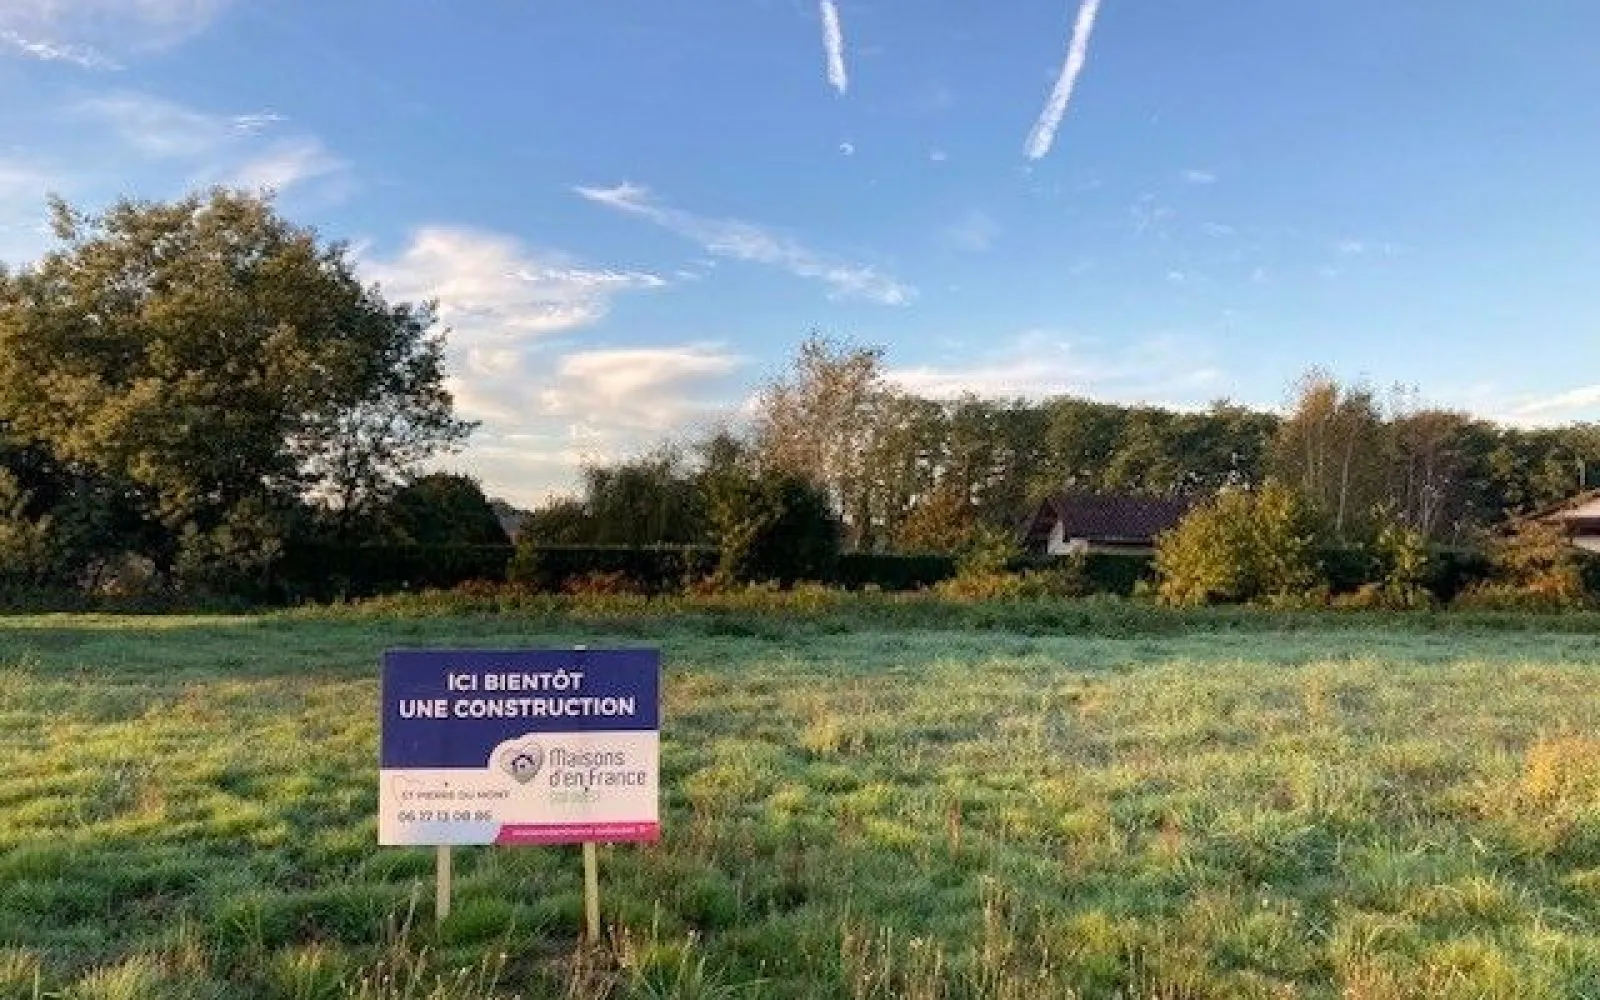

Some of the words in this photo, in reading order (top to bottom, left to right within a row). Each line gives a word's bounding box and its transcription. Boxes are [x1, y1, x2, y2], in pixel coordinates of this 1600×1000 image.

[448, 673, 478, 691] ICI
[484, 669, 584, 691] BIENTÔT
[400, 699, 448, 718] UNE
[454, 696, 636, 717] CONSTRUCTION
[549, 748, 626, 767] Maisons
[588, 769, 647, 787] France
